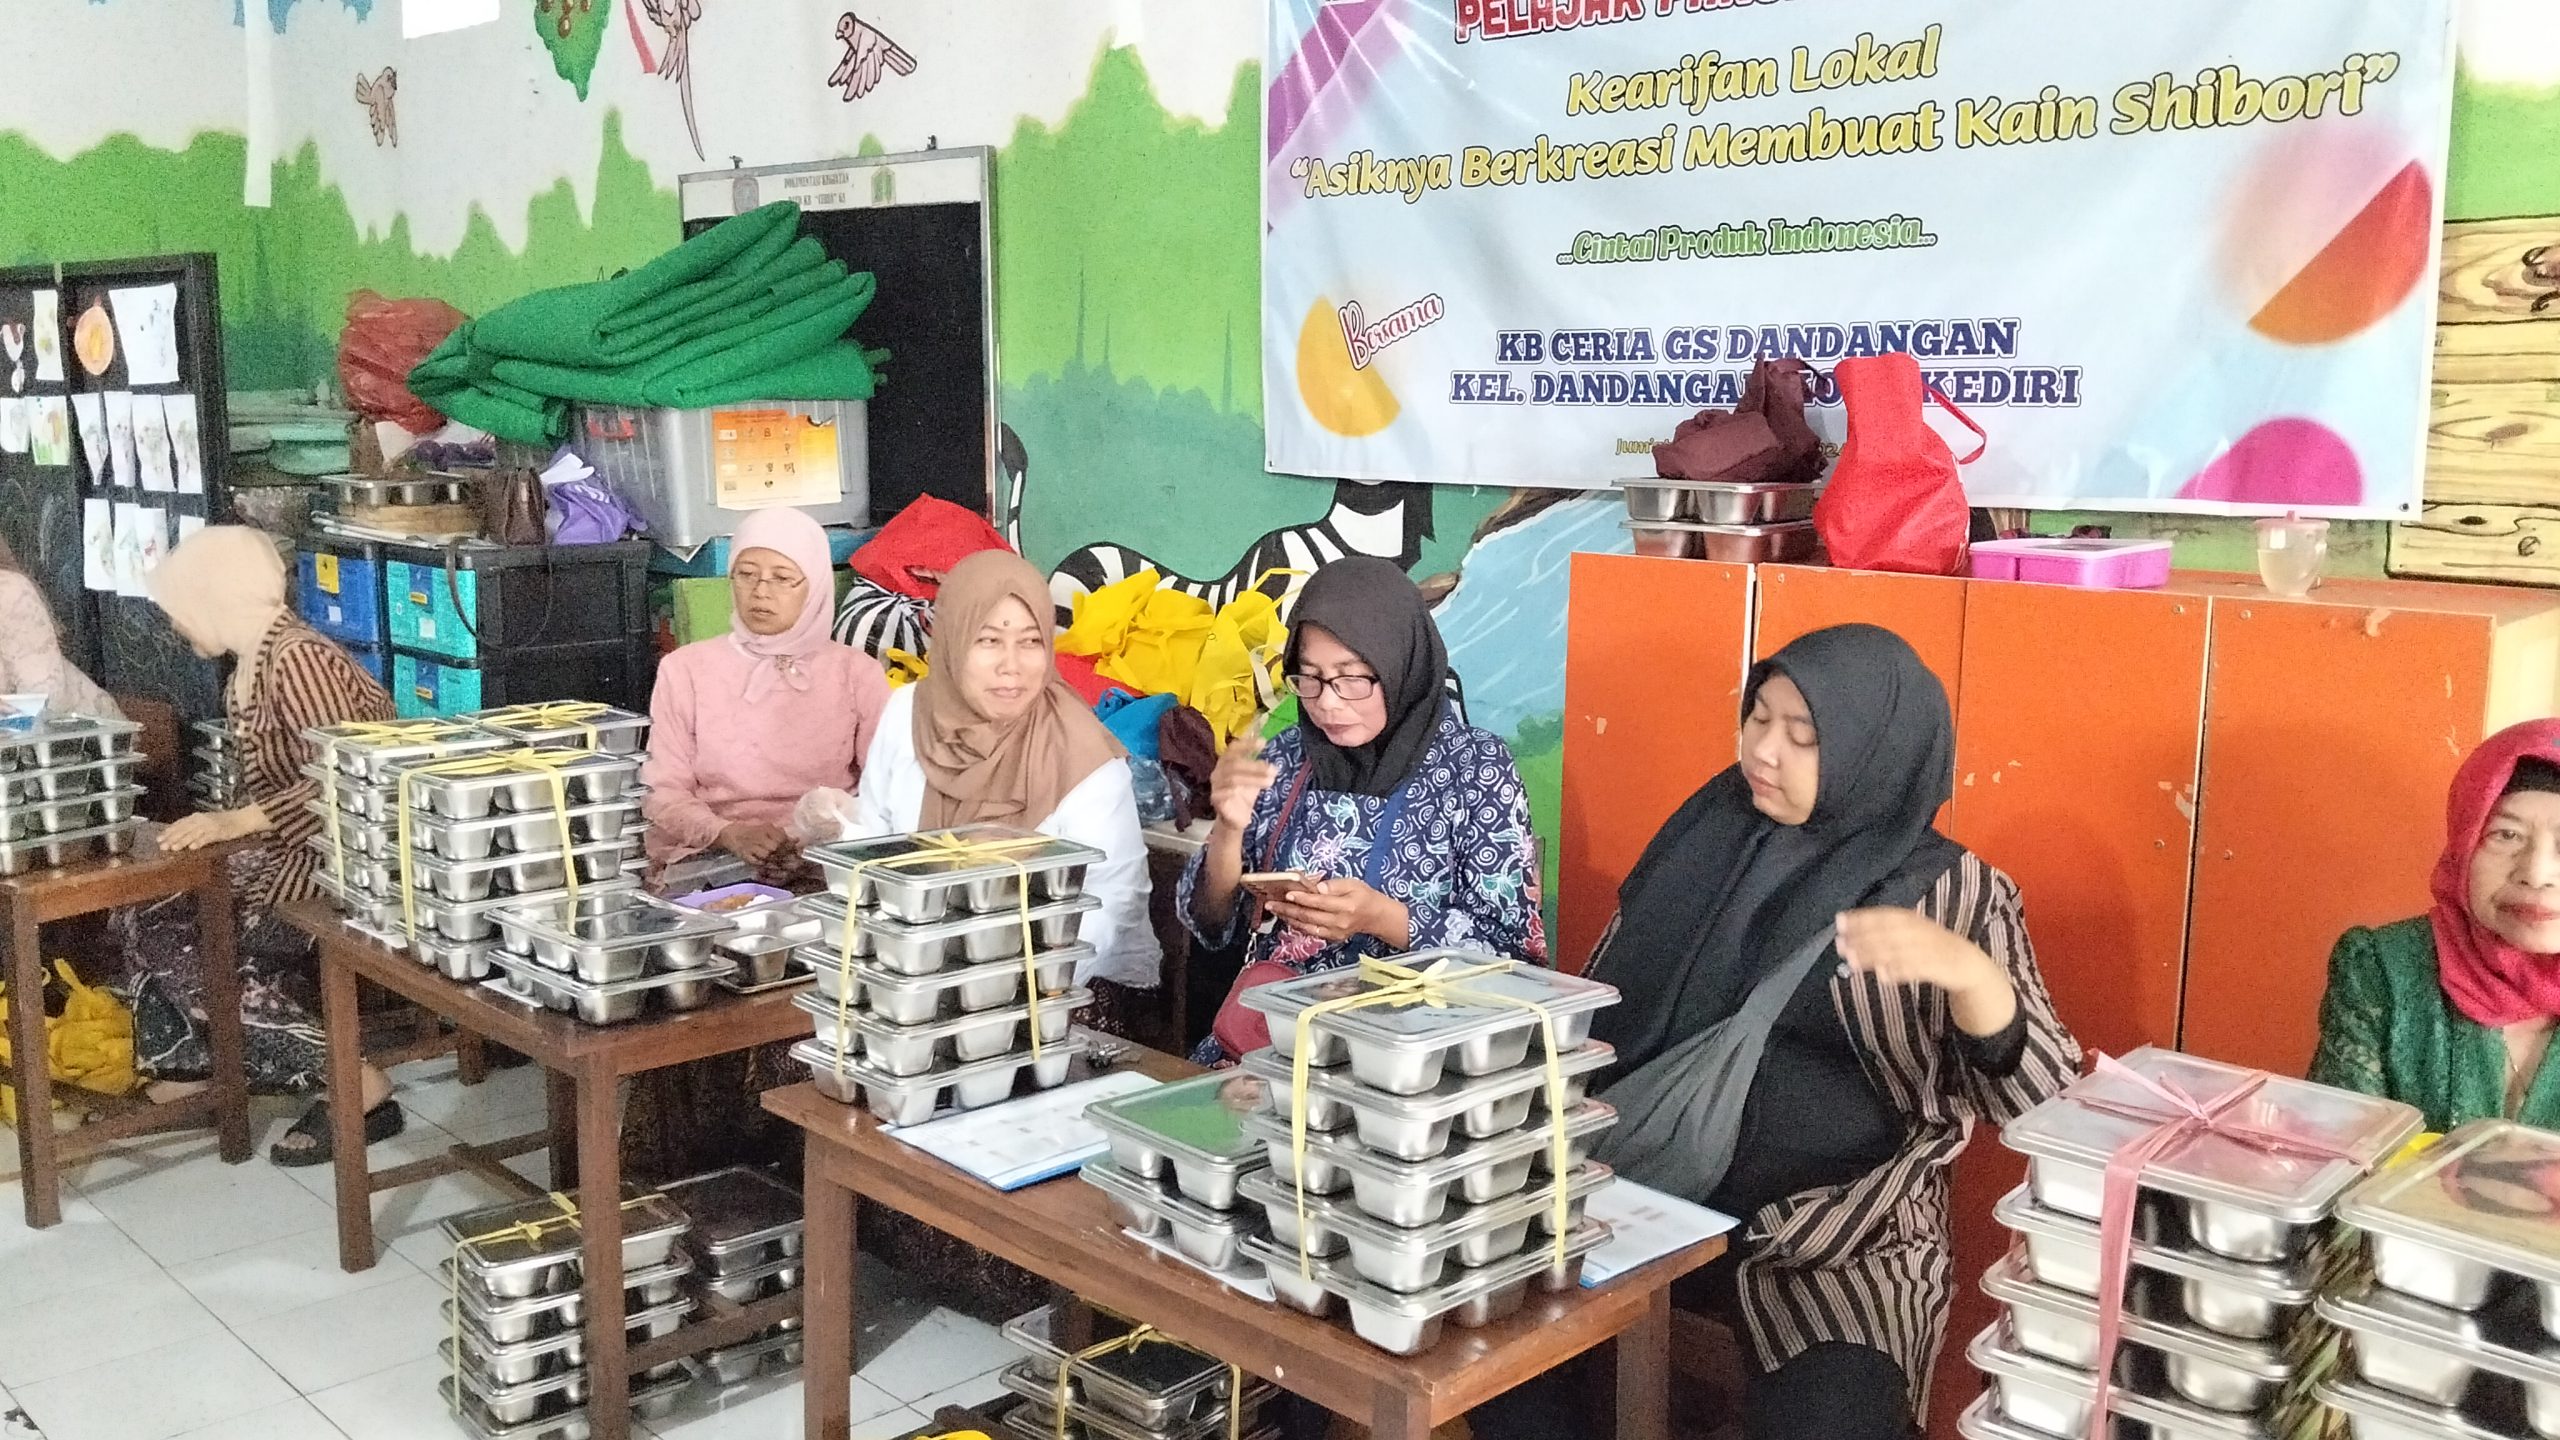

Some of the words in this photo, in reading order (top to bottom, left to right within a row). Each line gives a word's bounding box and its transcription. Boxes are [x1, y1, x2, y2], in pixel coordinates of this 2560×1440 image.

[1568, 51, 1776, 116] Kearifan
[1792, 24, 1941, 93] Lokal
[1461, 126, 1674, 187] Berkreasi
[1684, 101, 1944, 166] Membuat
[1956, 85, 2097, 148] Kain
[1659, 224, 1764, 260] Produk
[1338, 293, 1444, 370] Bersama
[1497, 329, 1545, 364] KB
[1548, 326, 1656, 363] CERIA
[1664, 324, 1720, 361] GS
[1726, 319, 2021, 361] DANDANGAN
[1450, 372, 1527, 405] KEL.
[1531, 370, 1753, 405] DANDANGA
[1922, 367, 2081, 408] KEDIRI
[1615, 437, 1672, 455] Jum'
